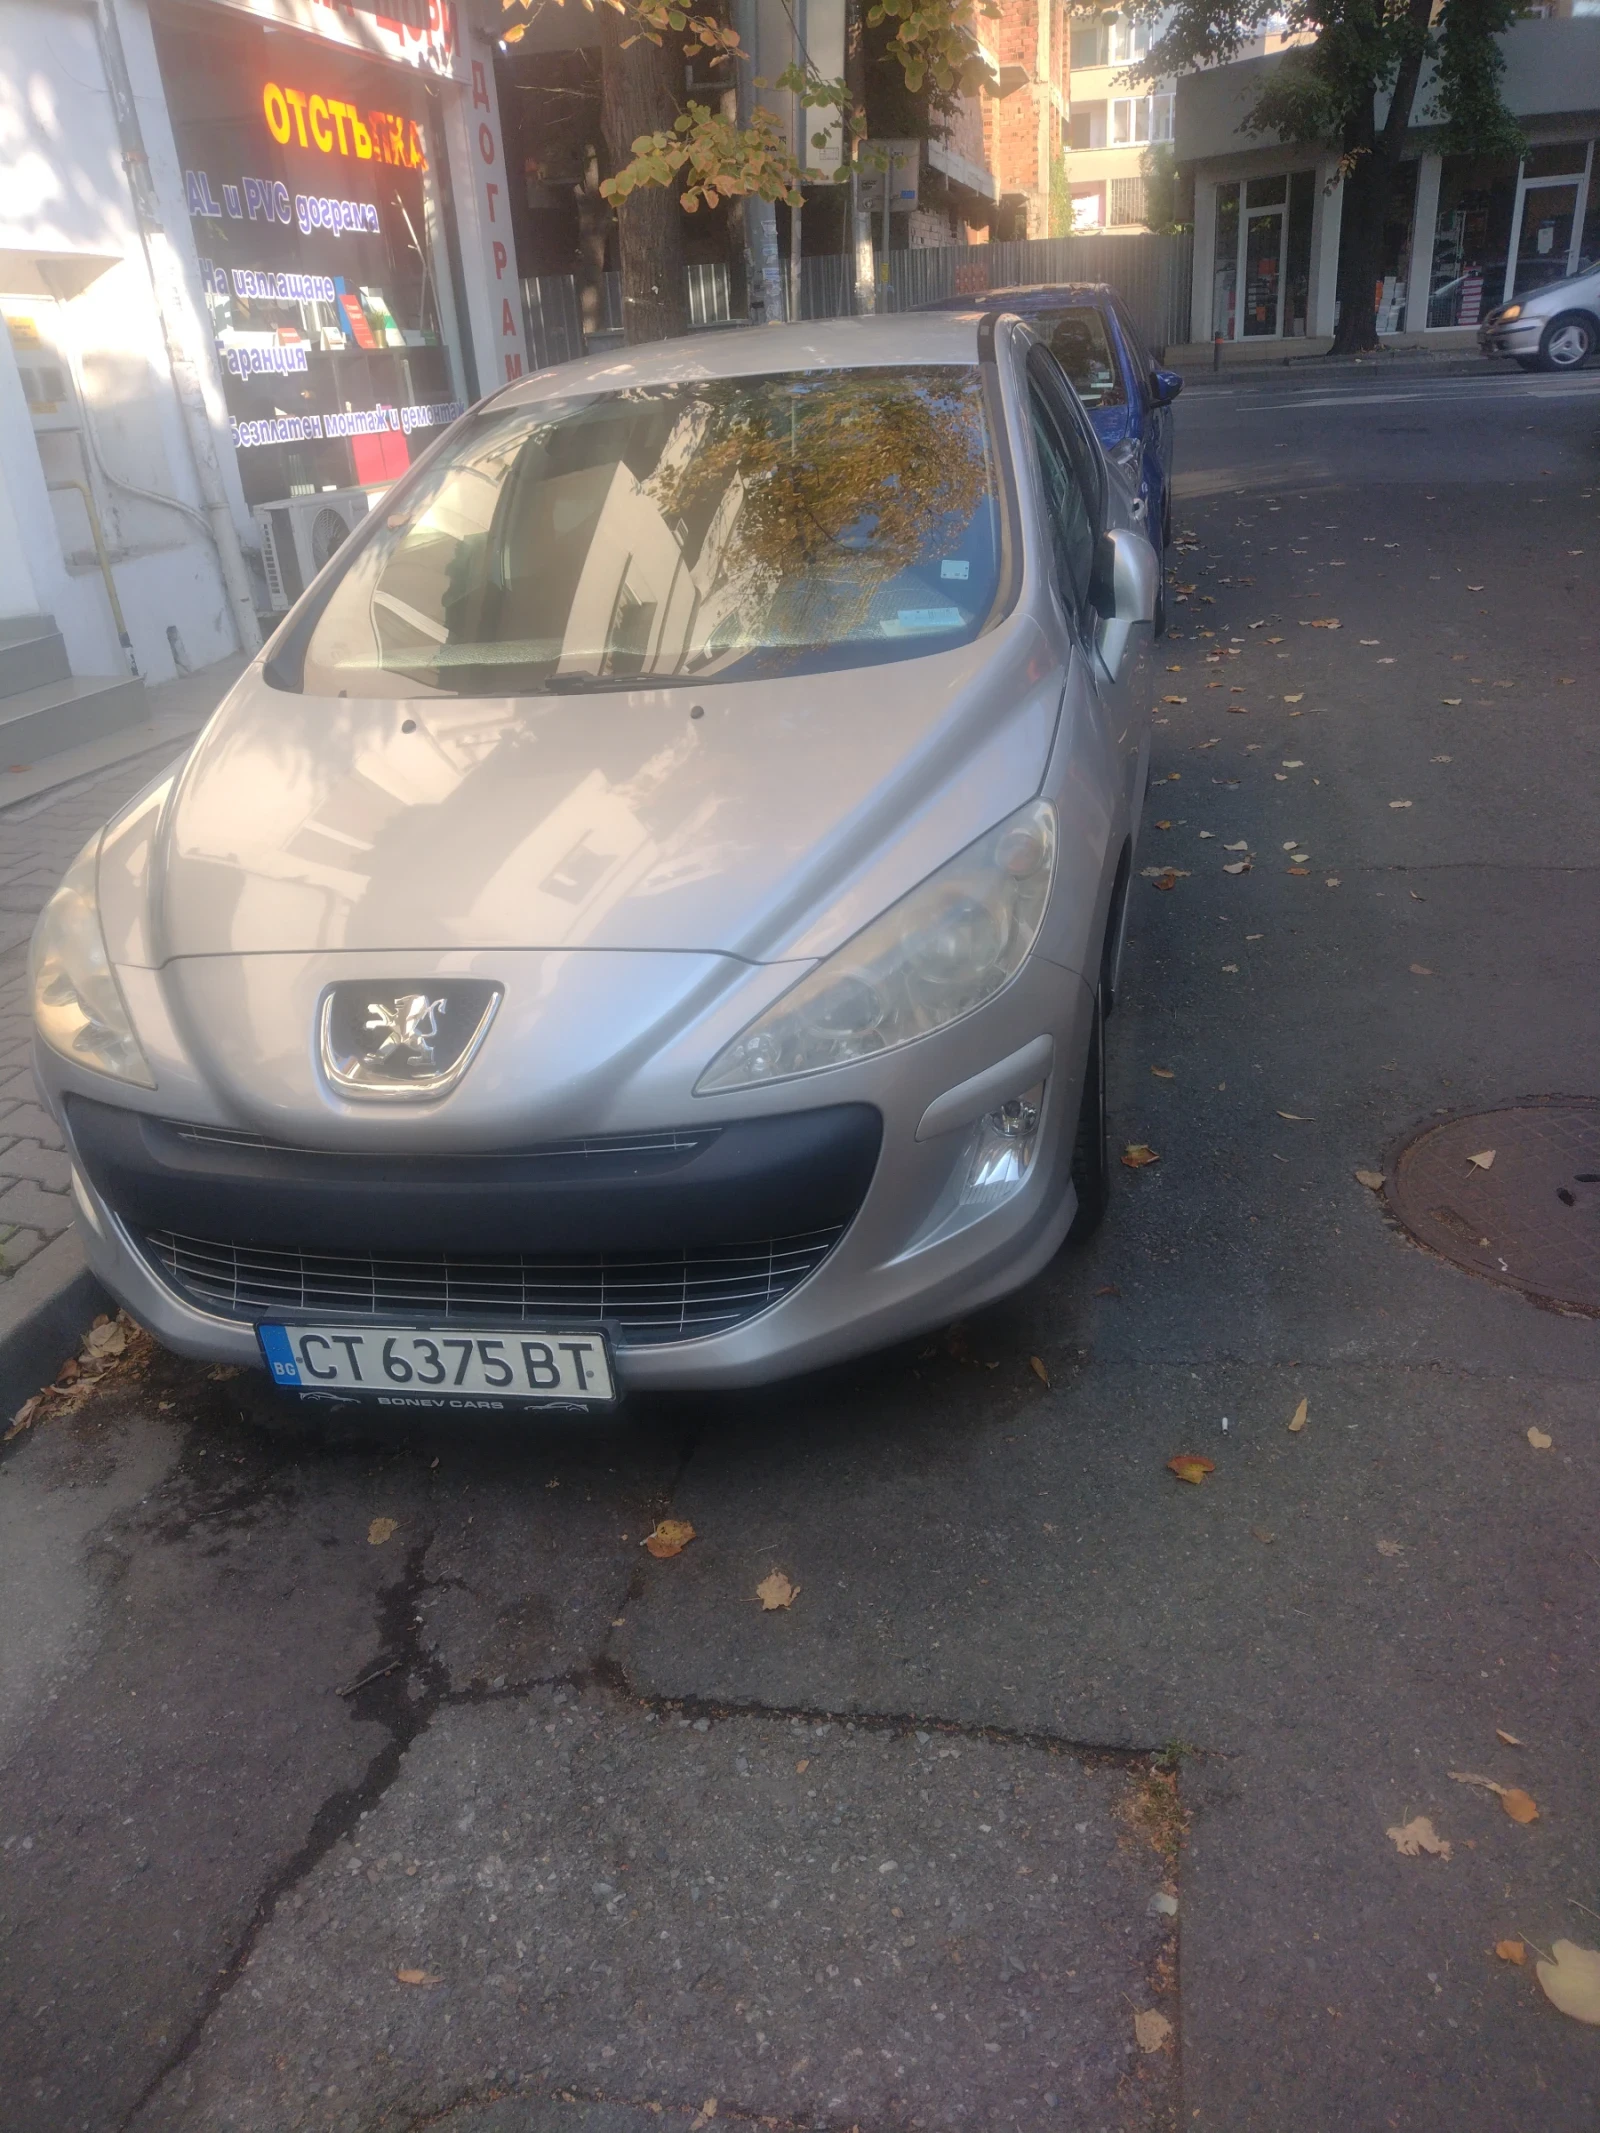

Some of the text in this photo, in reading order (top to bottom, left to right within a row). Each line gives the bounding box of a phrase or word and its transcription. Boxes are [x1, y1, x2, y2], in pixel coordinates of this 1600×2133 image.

[263, 82, 429, 171] ОТСТЪПКА
[184, 170, 380, 237] AL и PVC дограма
[199, 258, 335, 304] На изплащане
[325, 403, 389, 437] монтаж
[388, 409, 400, 431] и
[274, 1362, 296, 1376] BG
[299, 1333, 593, 1390] CT 6375 BT
[377, 1397, 504, 1409] BONEV CARS
